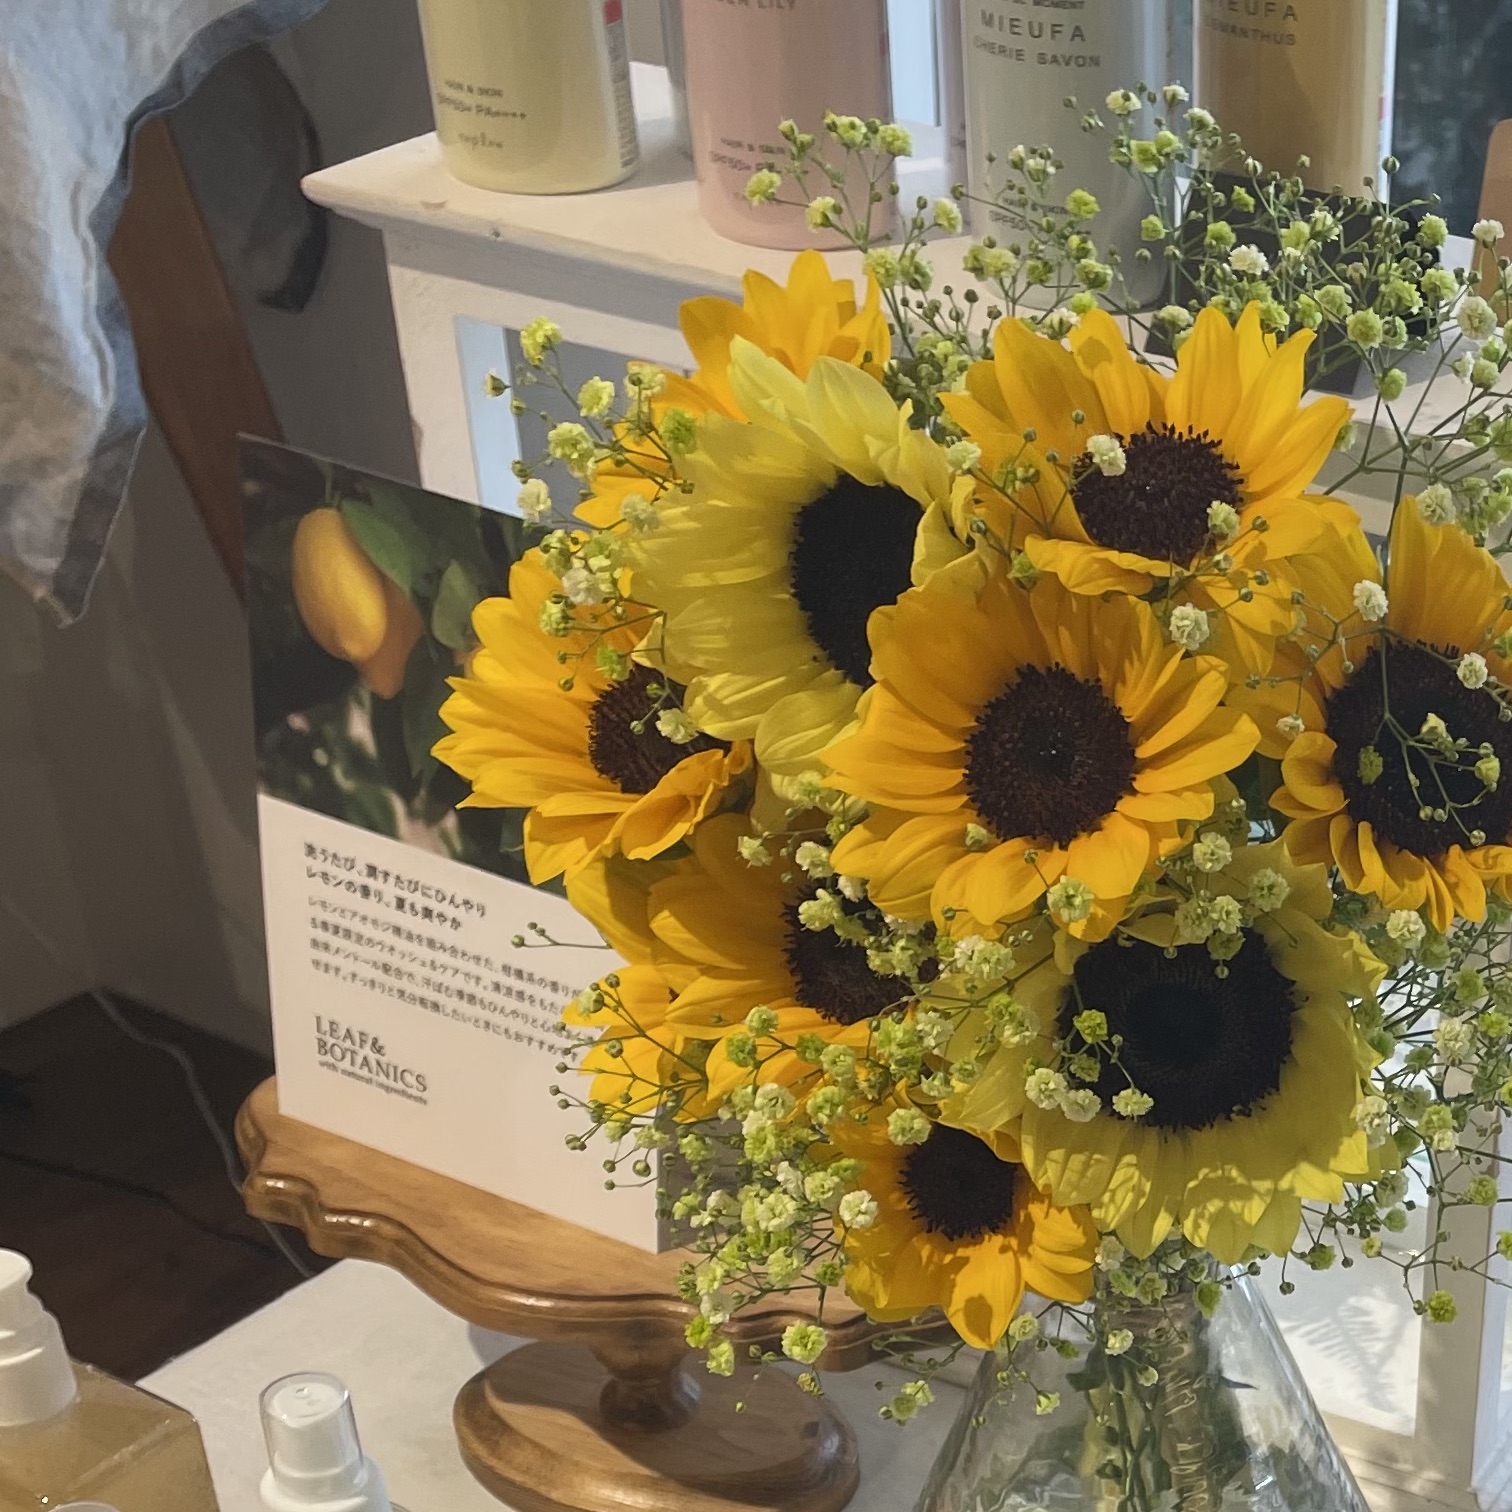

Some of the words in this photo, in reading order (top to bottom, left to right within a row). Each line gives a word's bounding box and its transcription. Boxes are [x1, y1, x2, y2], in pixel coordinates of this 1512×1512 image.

[980, 8, 1087, 42] MIEUFA
[315, 1015, 386, 1057] LEAF&
[315, 1037, 428, 1093] BOTANICS
